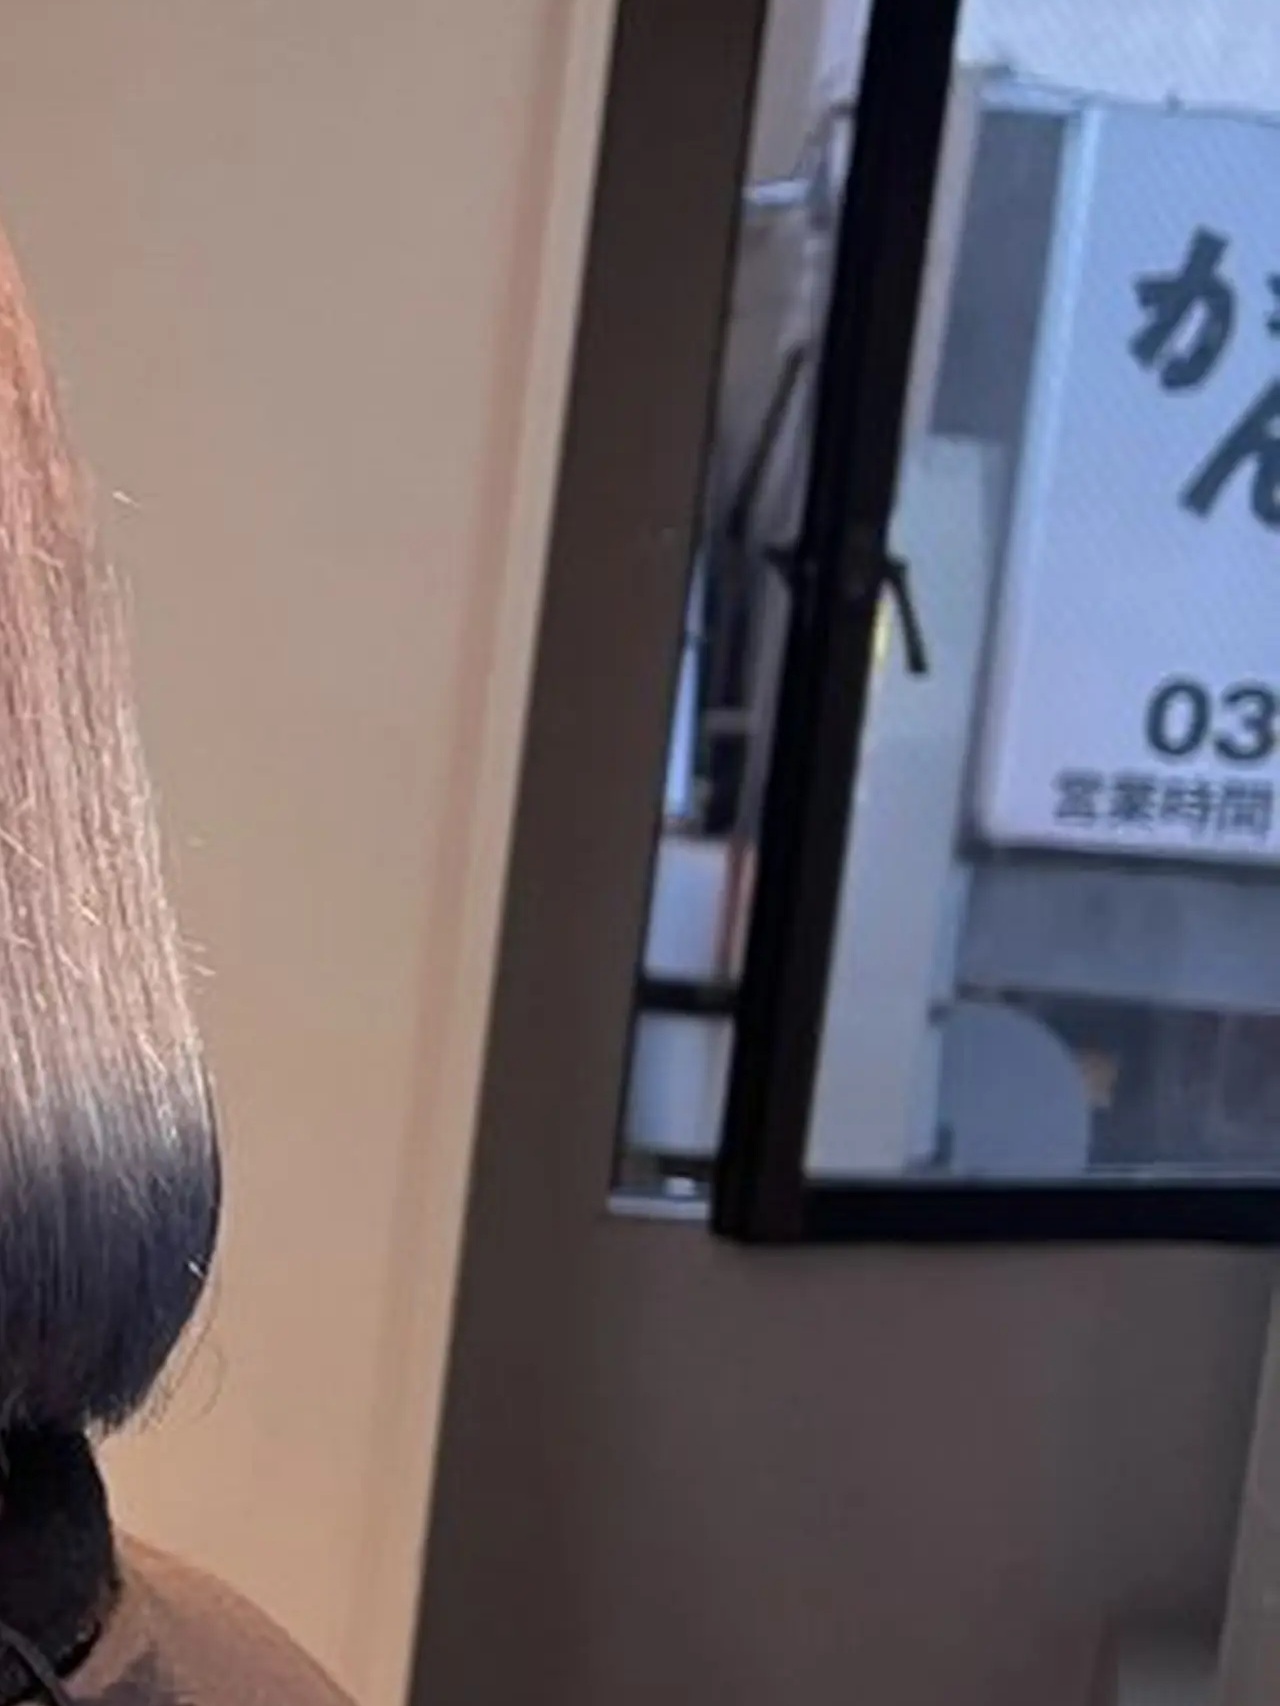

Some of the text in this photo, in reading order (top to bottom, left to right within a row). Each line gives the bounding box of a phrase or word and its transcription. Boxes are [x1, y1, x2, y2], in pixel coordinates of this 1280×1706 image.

[1146, 678, 1277, 763] 03
[1053, 770, 1275, 836] 営業時間
